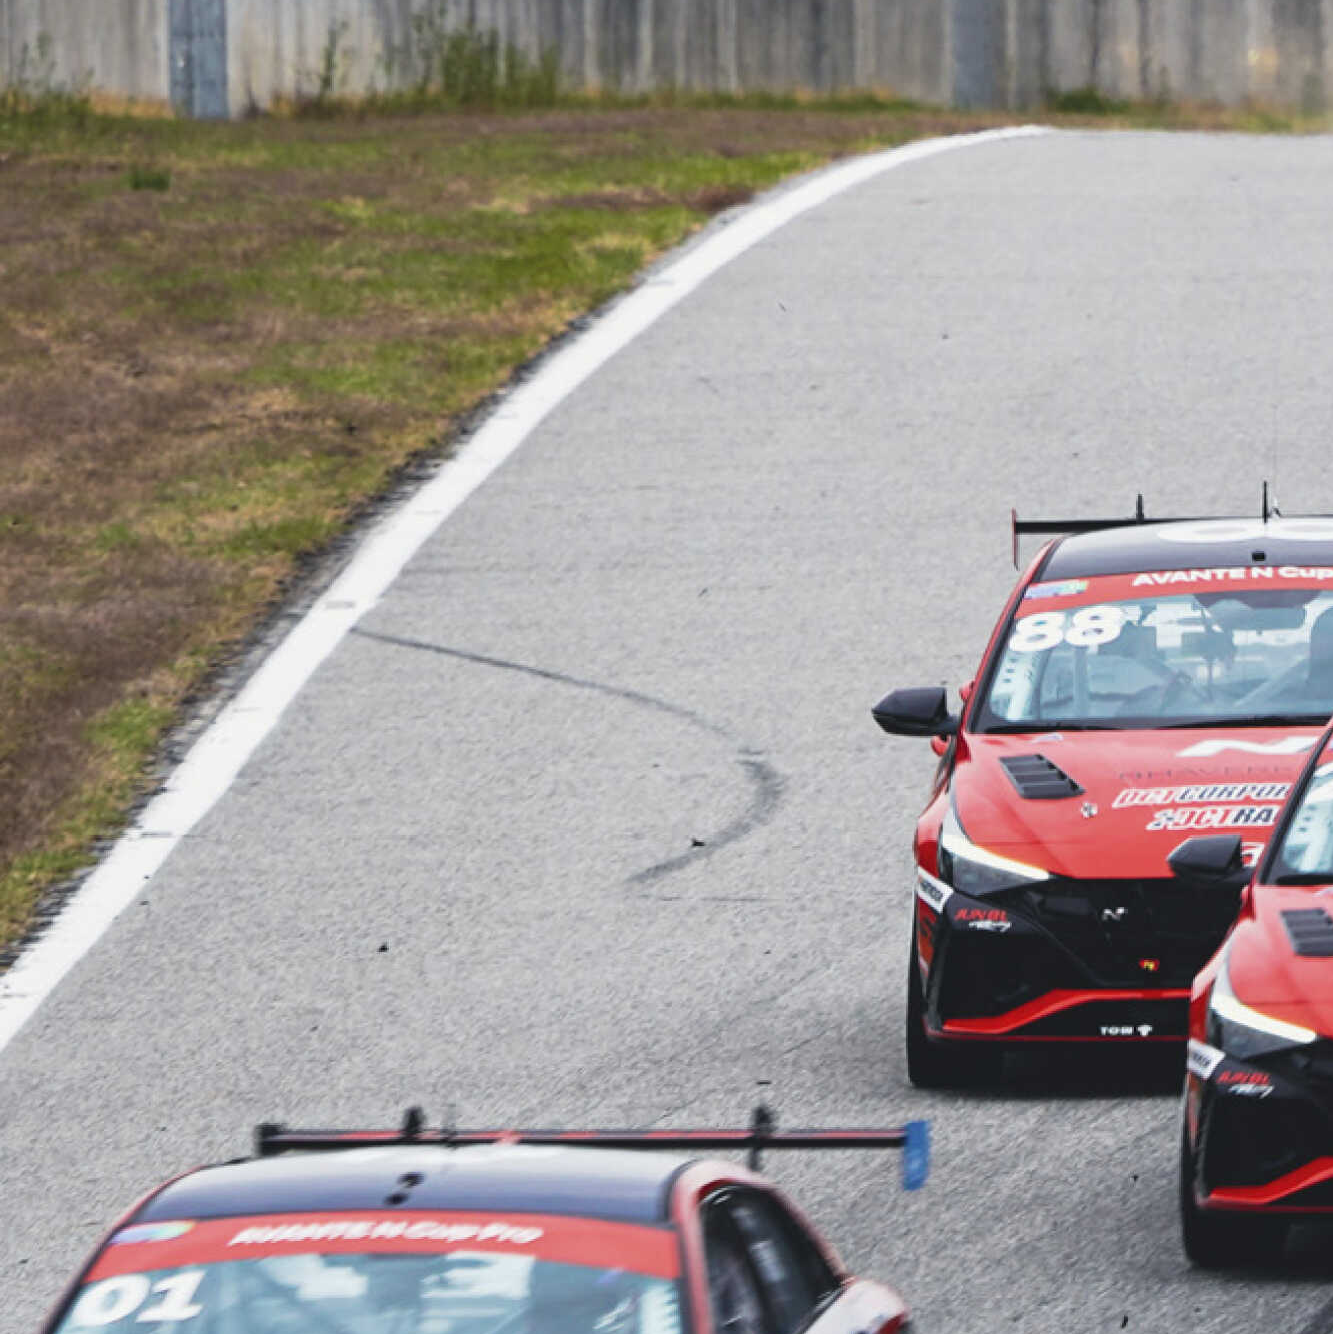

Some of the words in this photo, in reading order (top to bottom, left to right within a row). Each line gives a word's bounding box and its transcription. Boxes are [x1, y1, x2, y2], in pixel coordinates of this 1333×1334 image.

[1132, 568, 1244, 588] AVANTE
[1248, 567, 1274, 579] N
[1008, 604, 1124, 652] 88
[72, 1270, 206, 1327] 01
